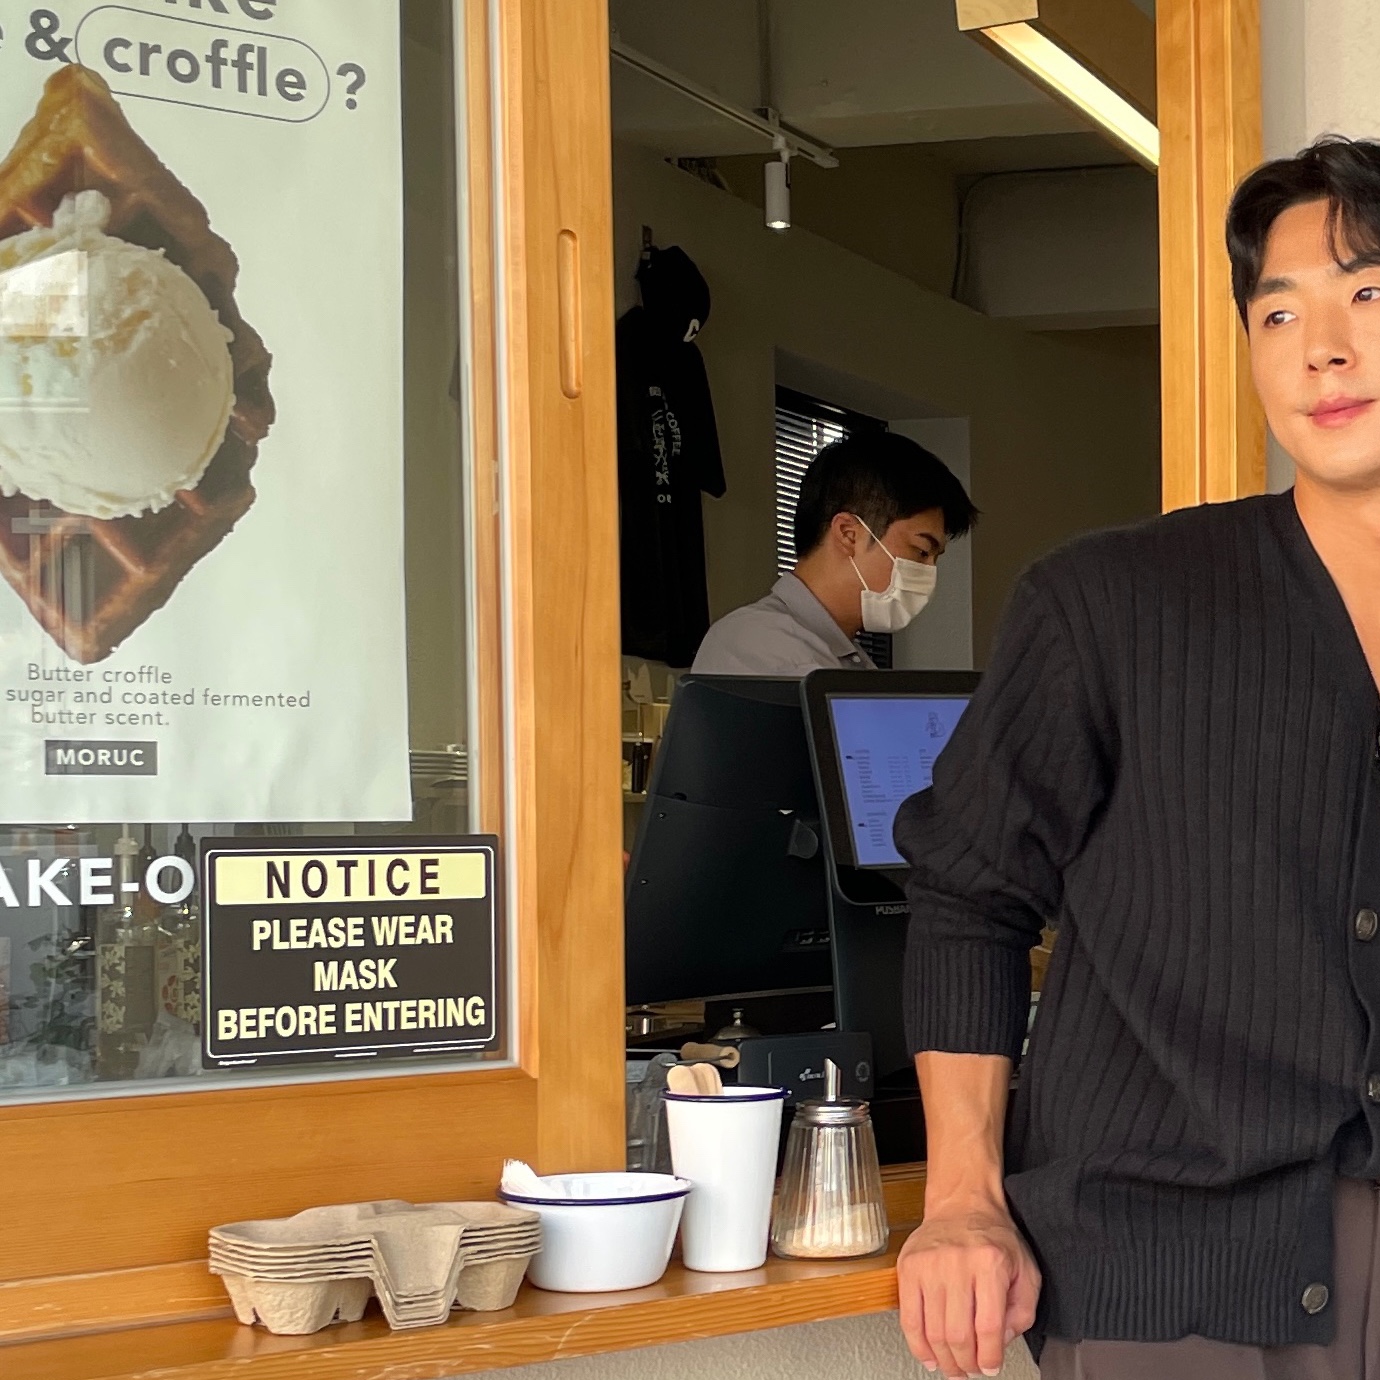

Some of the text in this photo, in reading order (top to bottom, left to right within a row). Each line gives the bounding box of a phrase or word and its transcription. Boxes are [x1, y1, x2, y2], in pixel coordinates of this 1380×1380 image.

[25, 9, 73, 63] &
[103, 37, 307, 102] croffle
[336, 62, 366, 110] ?
[27, 663, 173, 684] Butter croffle
[6, 686, 311, 708] sugar and coated fermented
[31, 703, 170, 726] butter scent.
[56, 748, 145, 766] MORUC
[266, 858, 441, 899] NOTICE
[252, 914, 454, 950] PLEASE WEAR
[313, 958, 398, 992] MASK
[217, 996, 486, 1040] BEFORE ENTERING
